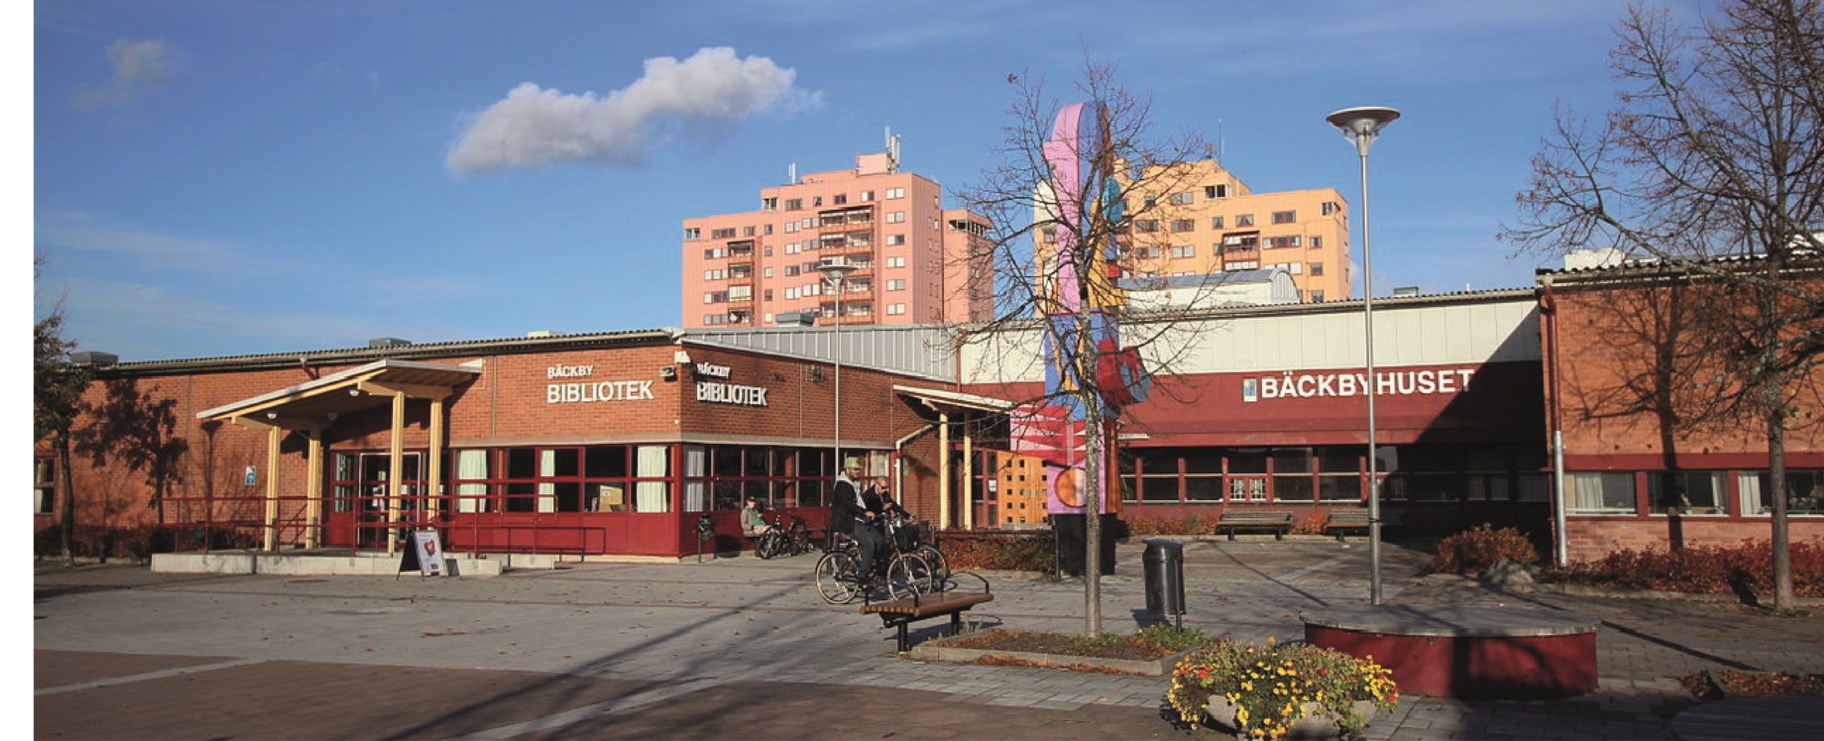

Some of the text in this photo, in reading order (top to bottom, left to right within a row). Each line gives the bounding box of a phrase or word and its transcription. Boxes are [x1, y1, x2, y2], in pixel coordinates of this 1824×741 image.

[547, 364, 594, 378] BÄCKBY
[547, 380, 655, 404] BIBLIOTEK
[697, 381, 768, 406] BIBLIOTEK
[1261, 369, 1475, 398] BÄCKBYHUSET
